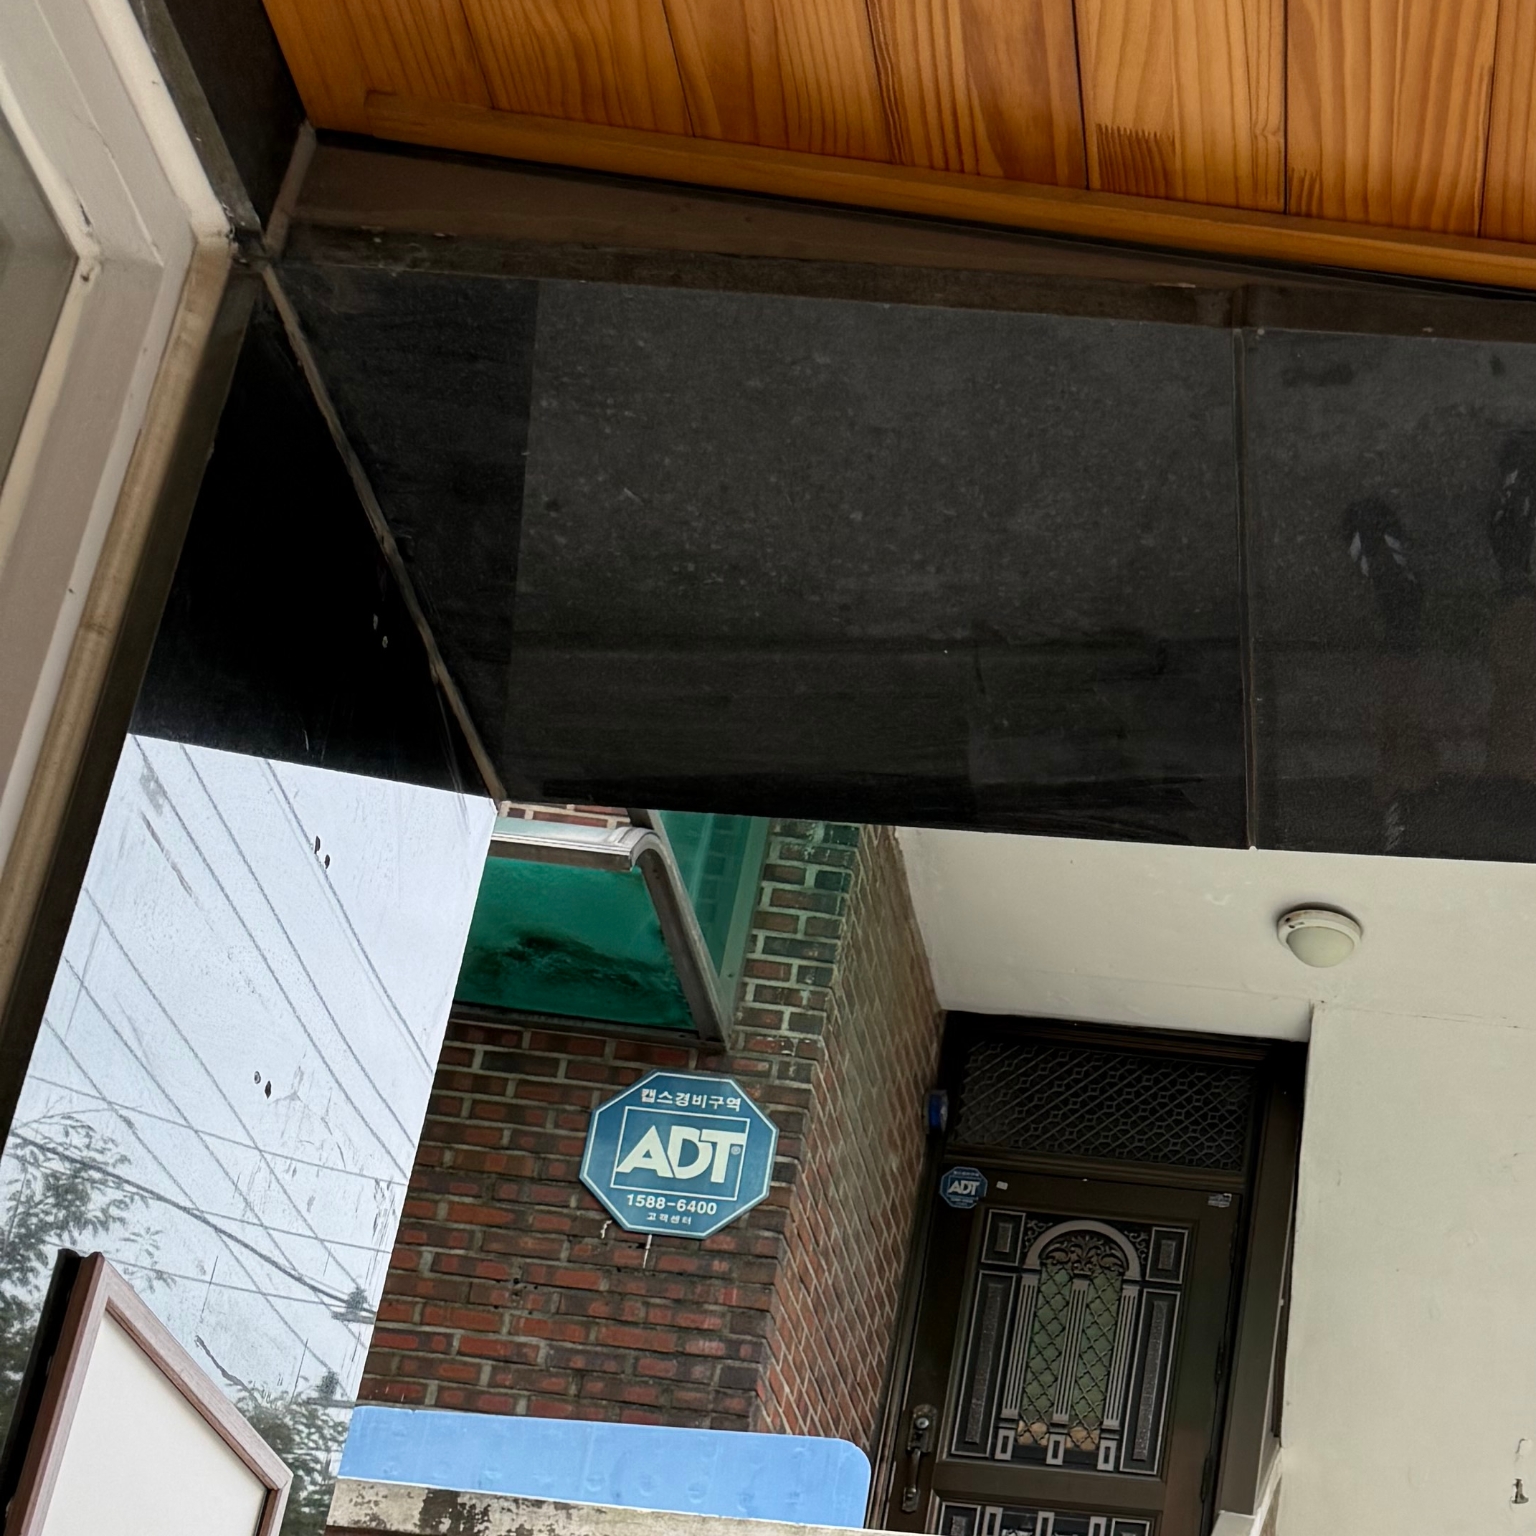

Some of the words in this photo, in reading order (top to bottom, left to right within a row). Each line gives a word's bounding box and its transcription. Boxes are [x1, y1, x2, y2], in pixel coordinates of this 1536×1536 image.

[641, 1088, 742, 1112] 캡스경비구역
[616, 1125, 746, 1184] ADT
[948, 1180, 981, 1196] ADT
[626, 1193, 717, 1215] 1588-6400
